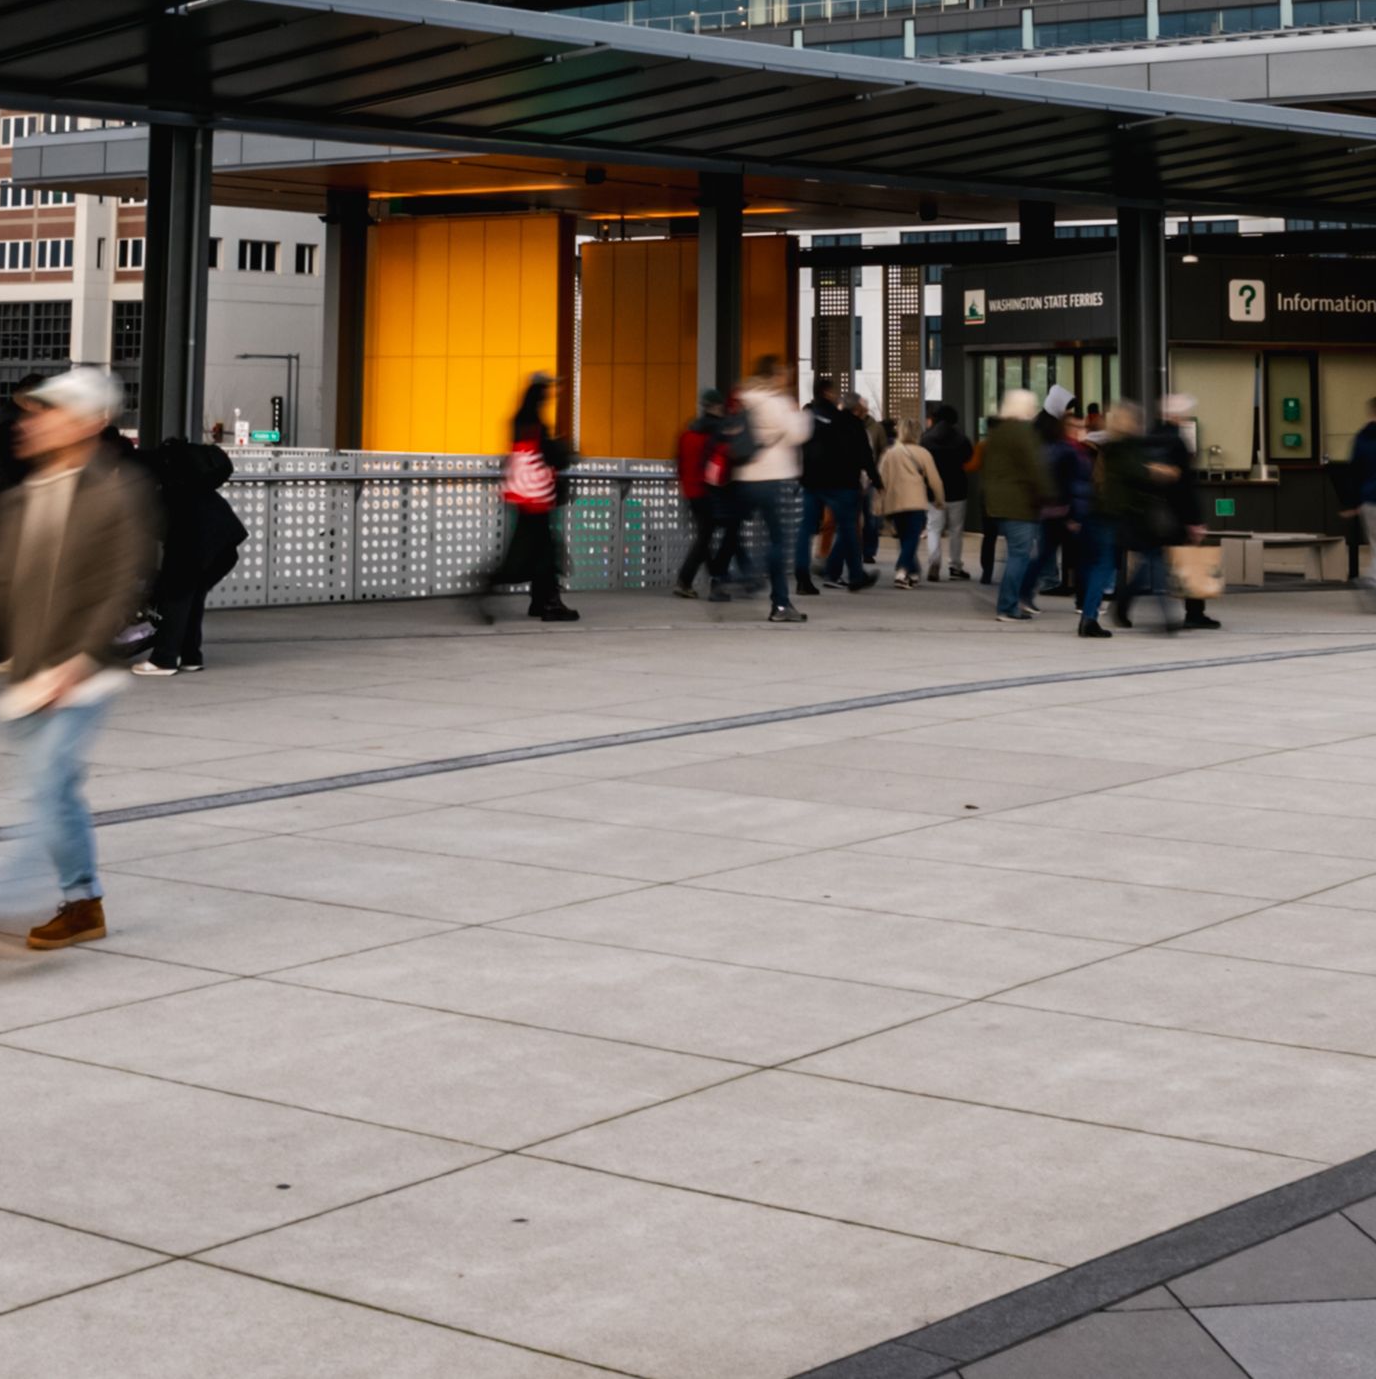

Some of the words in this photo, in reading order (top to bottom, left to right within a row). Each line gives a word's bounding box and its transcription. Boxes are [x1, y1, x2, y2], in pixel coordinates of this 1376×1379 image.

[988, 297, 1042, 312] WASHINGTON
[1044, 294, 1068, 309] STATE
[1069, 292, 1103, 307] FERRIES
